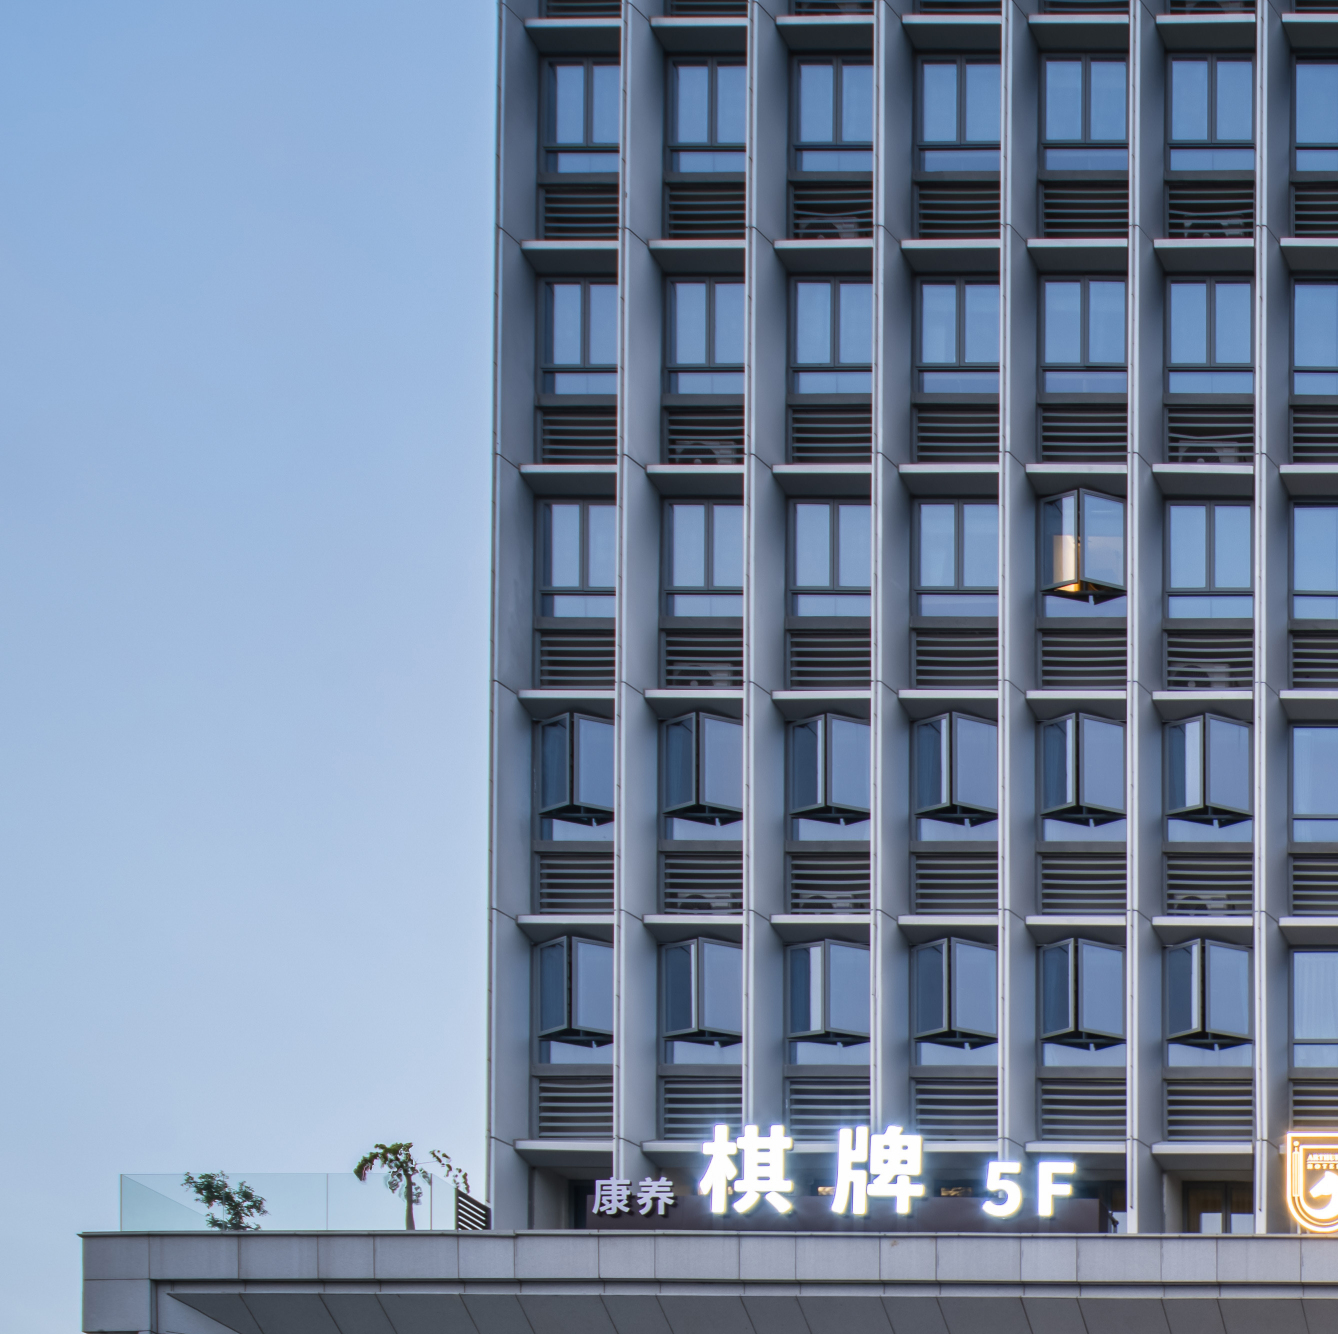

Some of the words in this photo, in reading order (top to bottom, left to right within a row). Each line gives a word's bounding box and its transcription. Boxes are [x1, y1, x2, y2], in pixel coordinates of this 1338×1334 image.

[592, 1175, 676, 1217] 康养
[699, 1122, 926, 1217] 棋牌
[981, 1159, 1078, 1218] 5F
